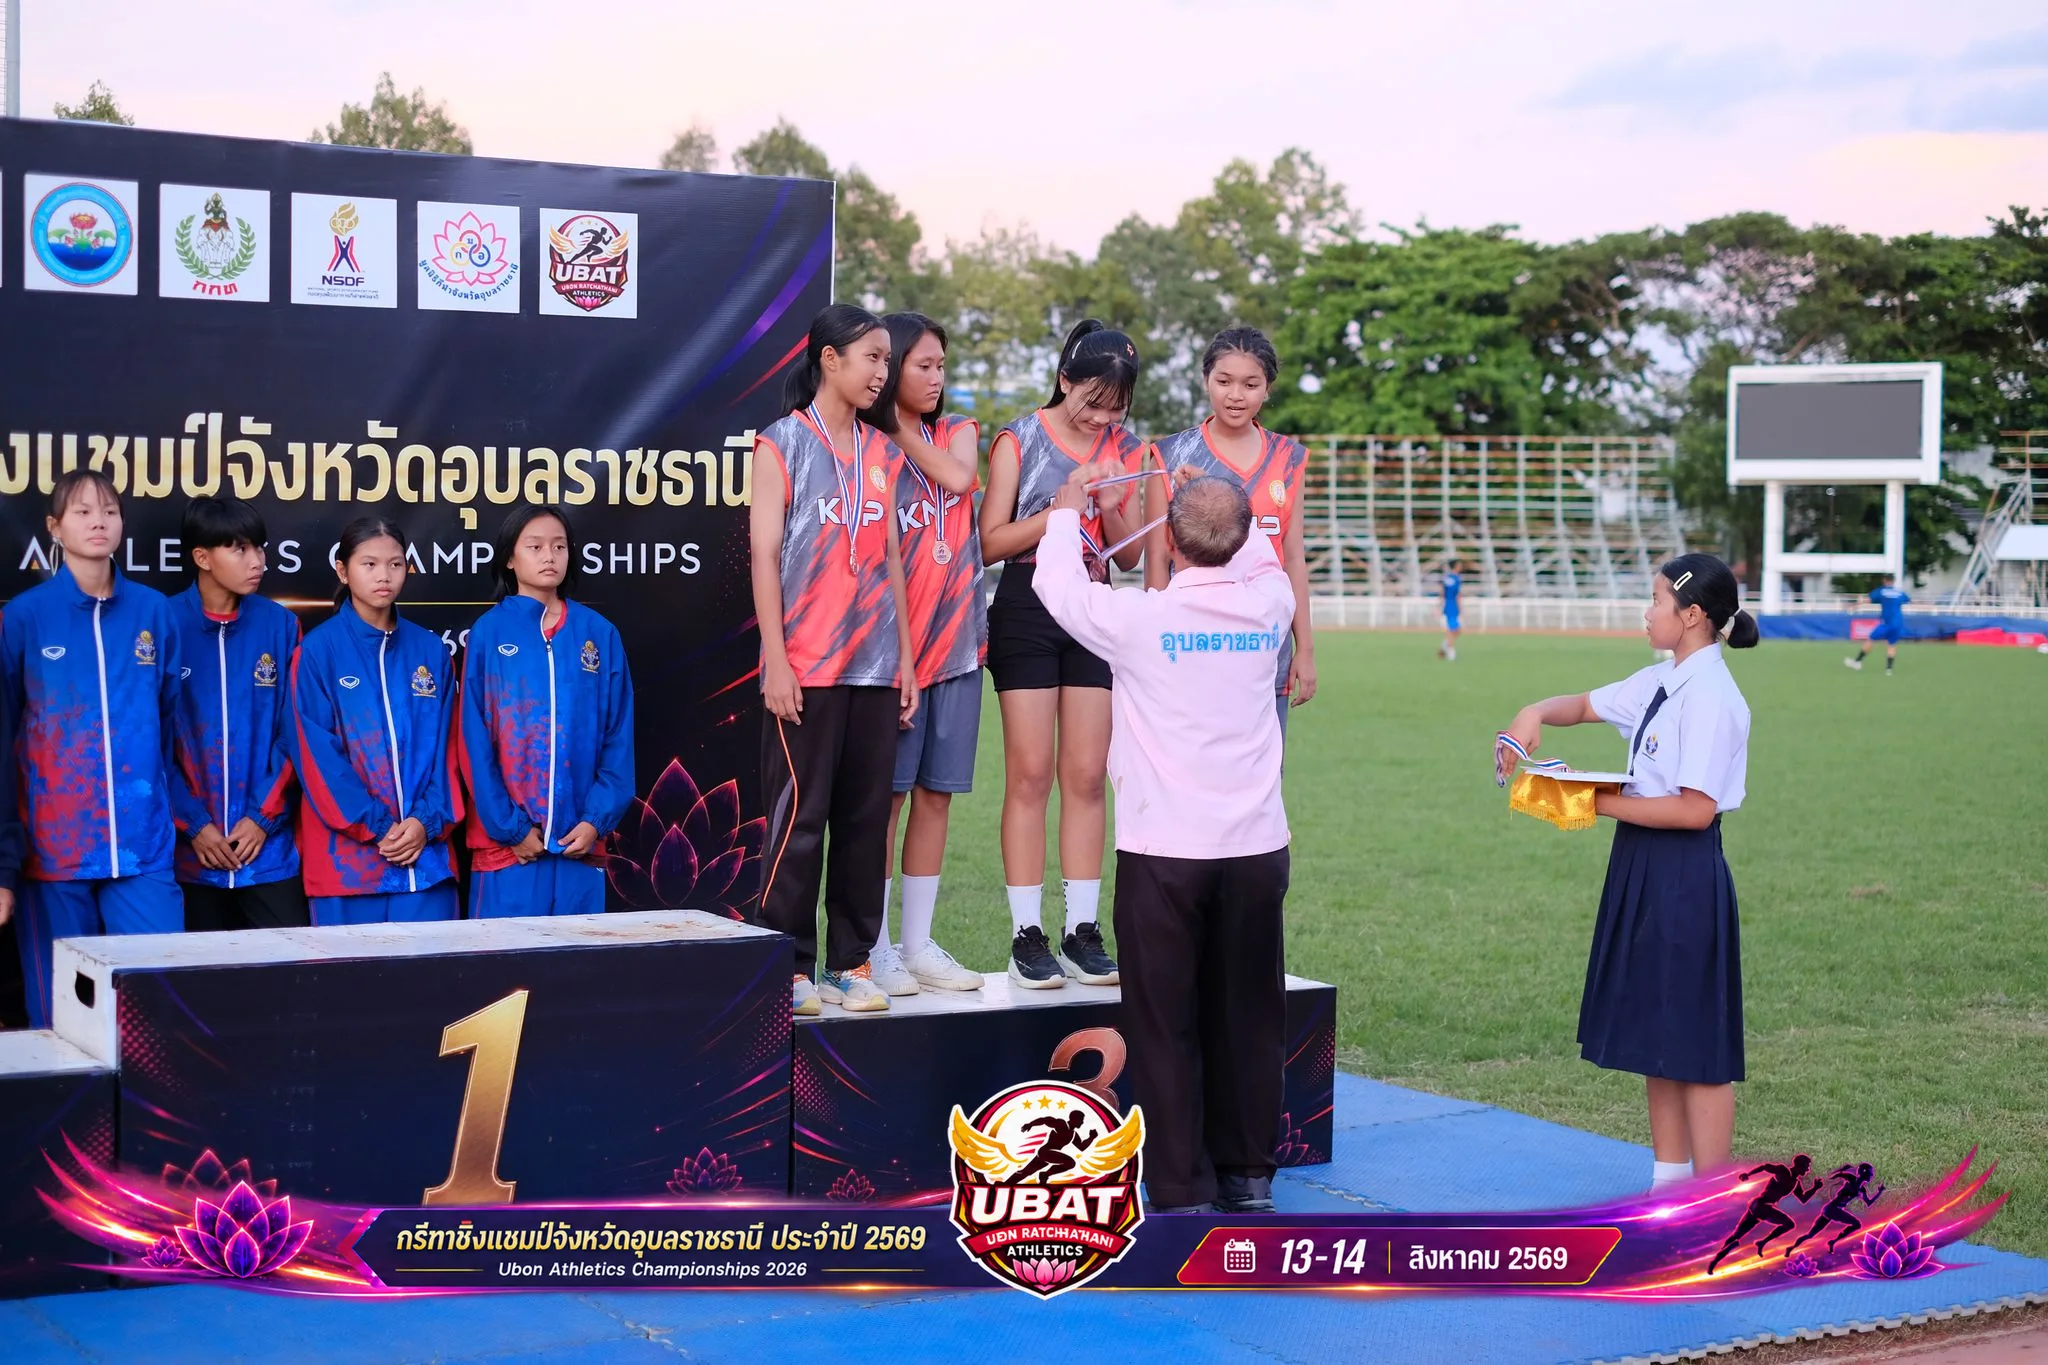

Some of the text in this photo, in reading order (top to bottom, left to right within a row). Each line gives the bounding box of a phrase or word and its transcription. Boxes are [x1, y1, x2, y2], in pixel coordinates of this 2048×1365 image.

[321, 275, 365, 287] NSDF
[555, 264, 622, 284] UBAT
[817, 497, 884, 527] KP
[421, 990, 529, 1207] 1
